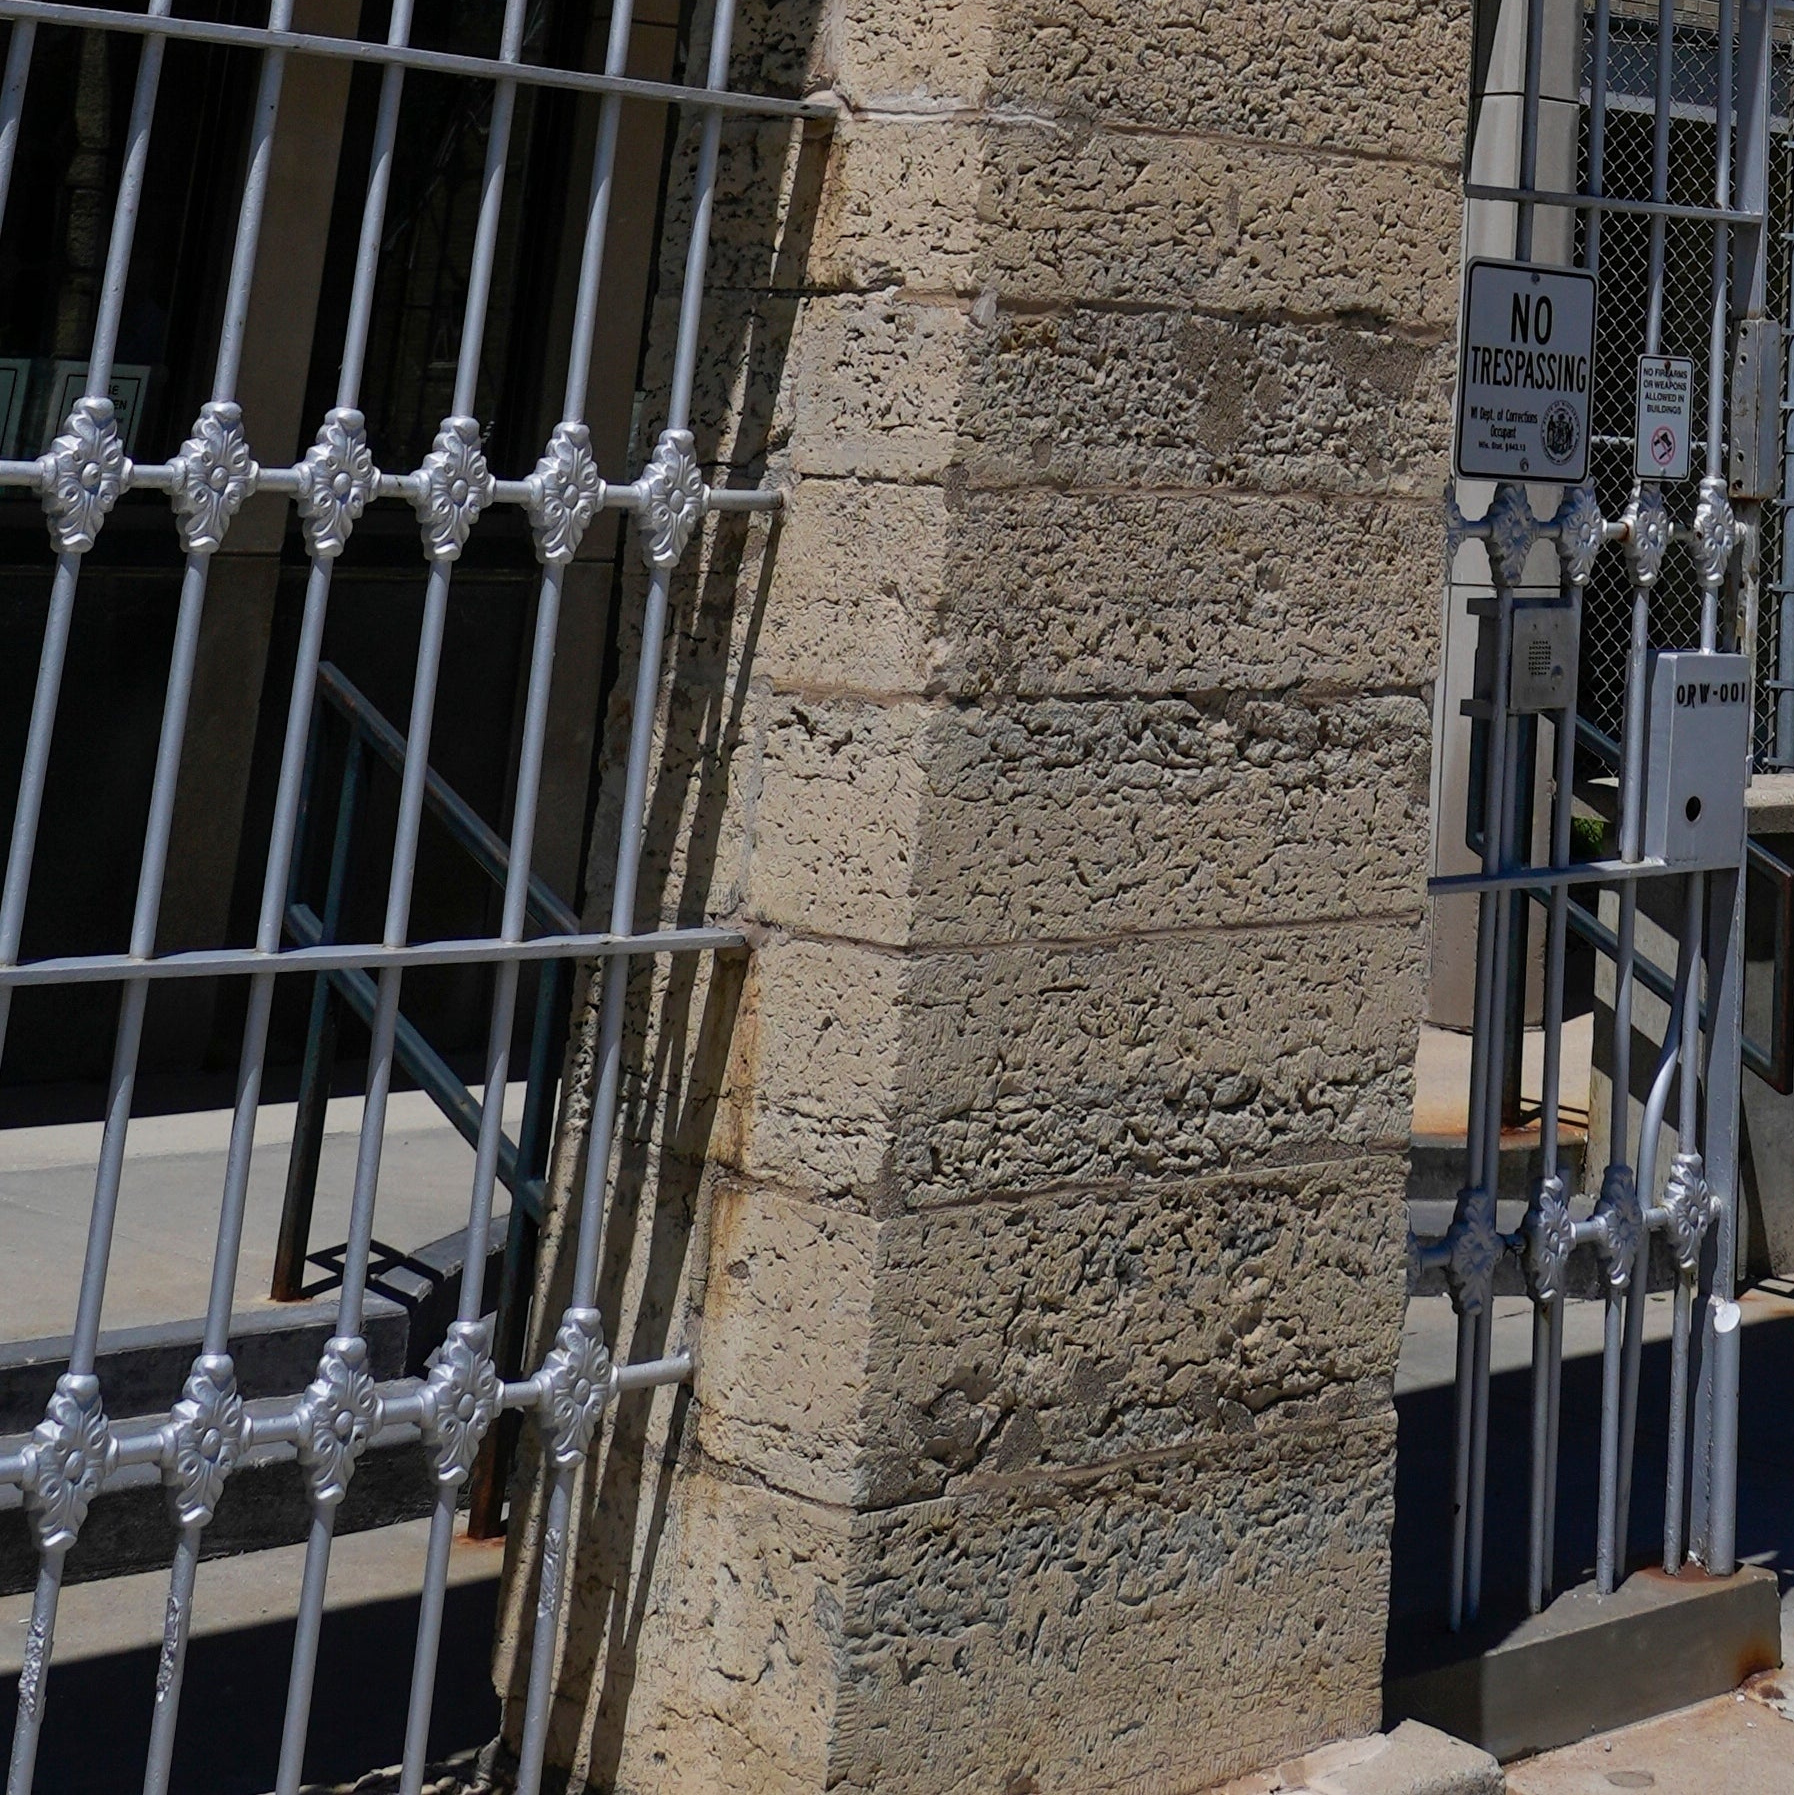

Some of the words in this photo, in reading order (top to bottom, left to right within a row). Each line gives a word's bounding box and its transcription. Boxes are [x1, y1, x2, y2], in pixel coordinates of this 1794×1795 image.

[1511, 292, 1553, 345] NO
[1471, 345, 1587, 393] TRESPASSING
[1643, 367, 1654, 377] NO
[1655, 368, 1688, 379] FIREARMS
[1643, 379, 1653, 388] OR
[1654, 380, 1687, 391] WEAPONS
[1645, 392, 1677, 401] ALLOWED
[1677, 394, 1685, 403] IN
[1480, 407, 1495, 423] Dept.
[1497, 409, 1503, 421] of
[1505, 409, 1539, 424] Corrections
[1646, 404, 1682, 415] BUILDINGS
[1490, 424, 1517, 440] Occupant
